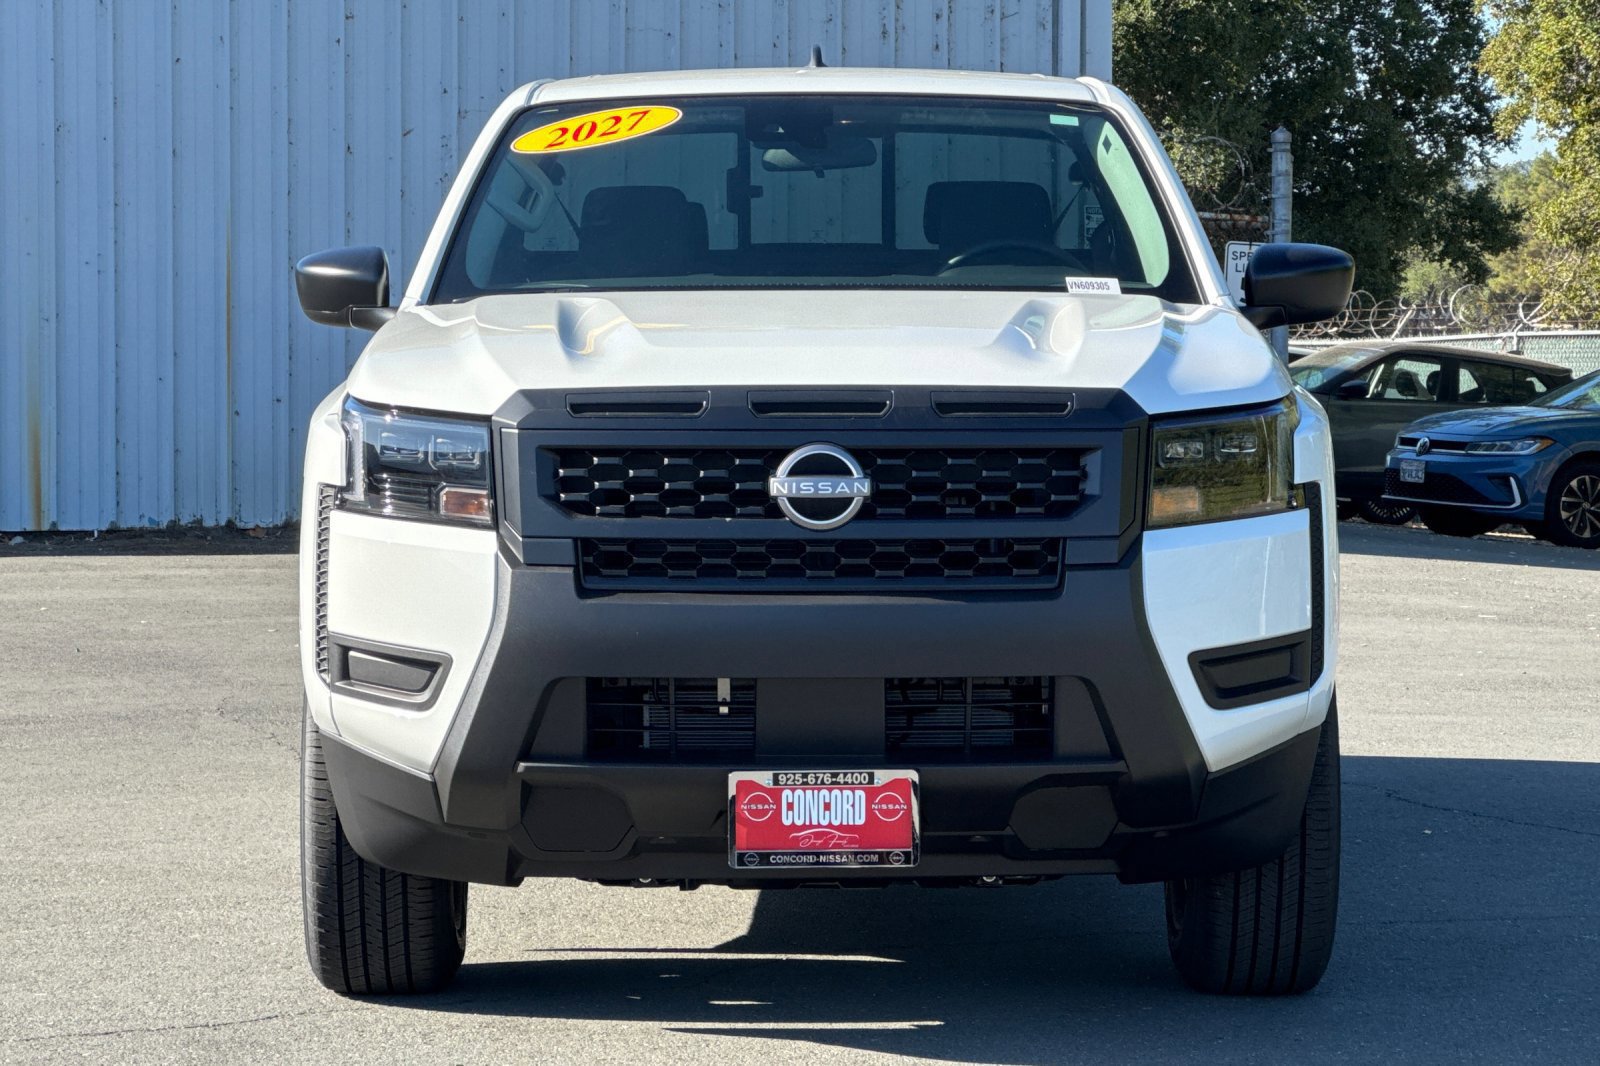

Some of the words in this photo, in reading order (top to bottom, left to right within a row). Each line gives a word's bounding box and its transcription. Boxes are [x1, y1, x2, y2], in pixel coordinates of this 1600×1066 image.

[543, 109, 652, 150] 2027
[1231, 250, 1254, 261] SPE
[1068, 280, 1110, 291] VN609305
[773, 482, 868, 494] NISSAN
[778, 772, 869, 785] 925-676-4400
[781, 788, 866, 827] CONCORD
[769, 854, 879, 864] CONCORD-NISSAN.COM
